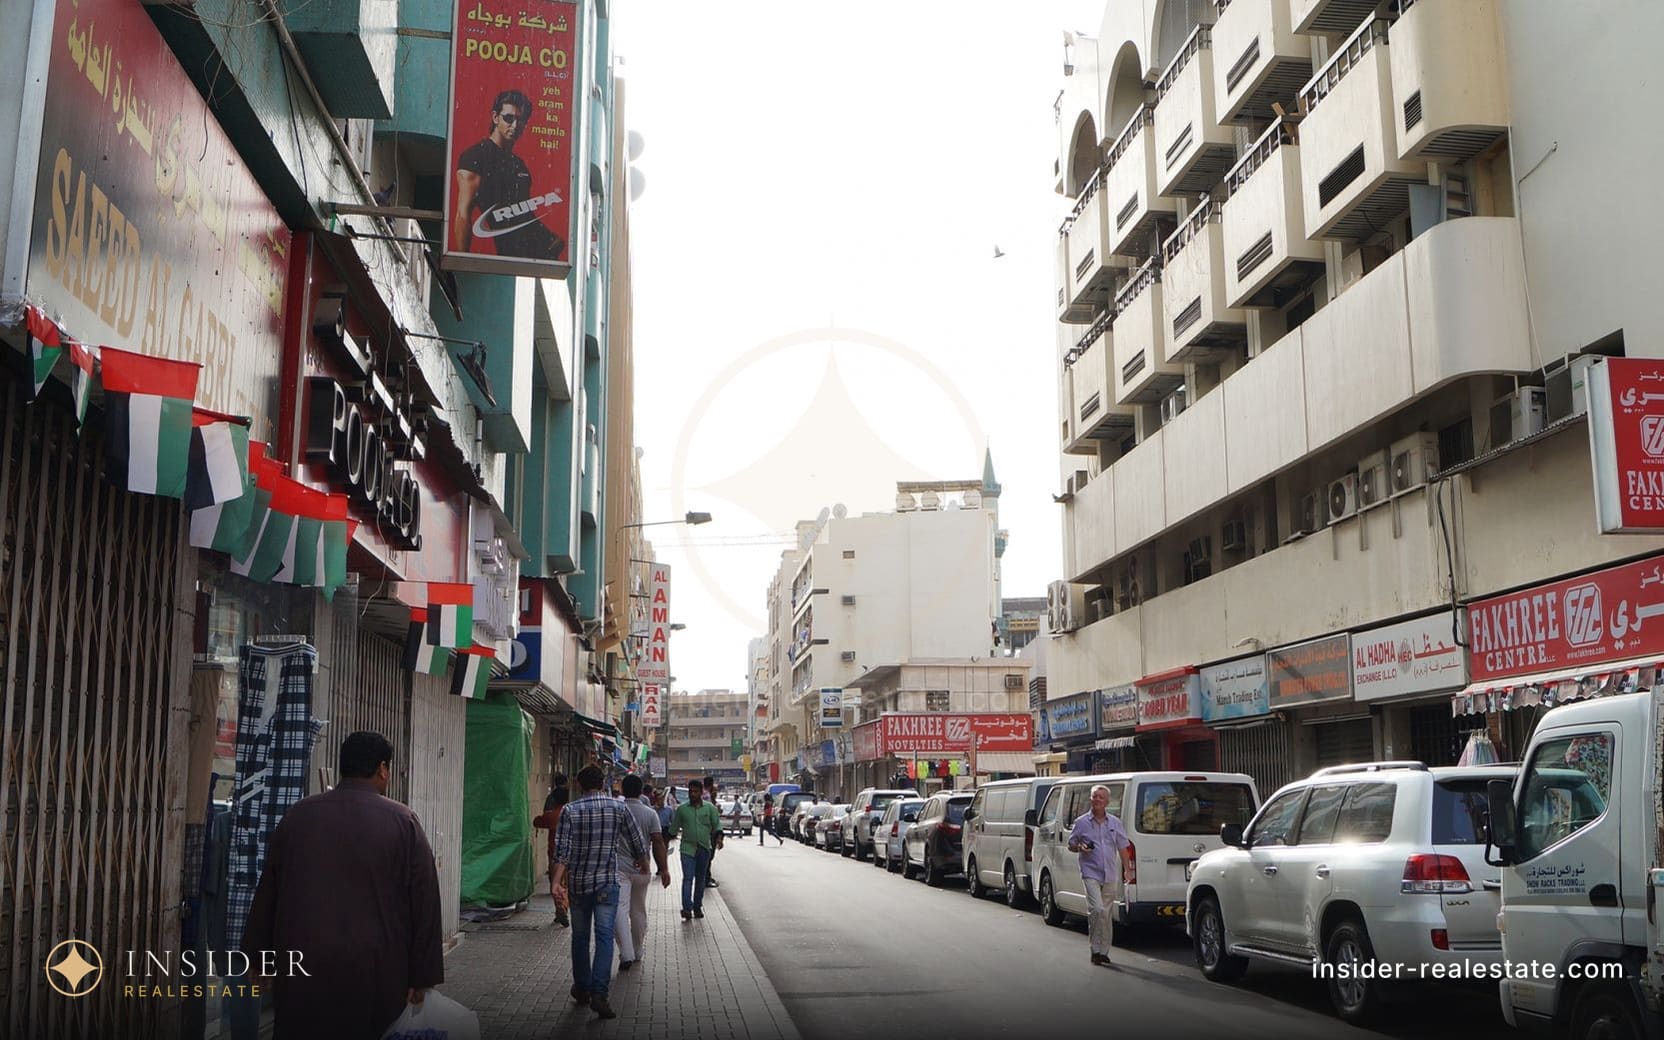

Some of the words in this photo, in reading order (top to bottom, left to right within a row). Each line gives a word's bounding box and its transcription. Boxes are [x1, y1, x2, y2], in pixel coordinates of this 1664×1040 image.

[518, 10, 568, 34] شركة
[466, 38, 533, 65] POOJA
[539, 47, 567, 69] CO
[542, 86, 560, 96] yeh
[538, 99, 564, 110] aram
[546, 112, 558, 122] ka
[532, 126, 565, 137] mamla
[540, 139, 559, 150] hai!
[492, 192, 563, 222] RUPA
[47, 148, 141, 338] SAEED
[141, 251, 173, 355] AL
[654, 570, 667, 582] AL
[652, 588, 667, 662] AMAN
[1471, 592, 1559, 653] FAKHREE
[1356, 647, 1367, 669] AL
[1368, 640, 1397, 666] HADHA
[1486, 644, 1546, 672] CENTRE
[888, 717, 943, 736] FAKHREE
[888, 739, 943, 750] NOVELTIES
